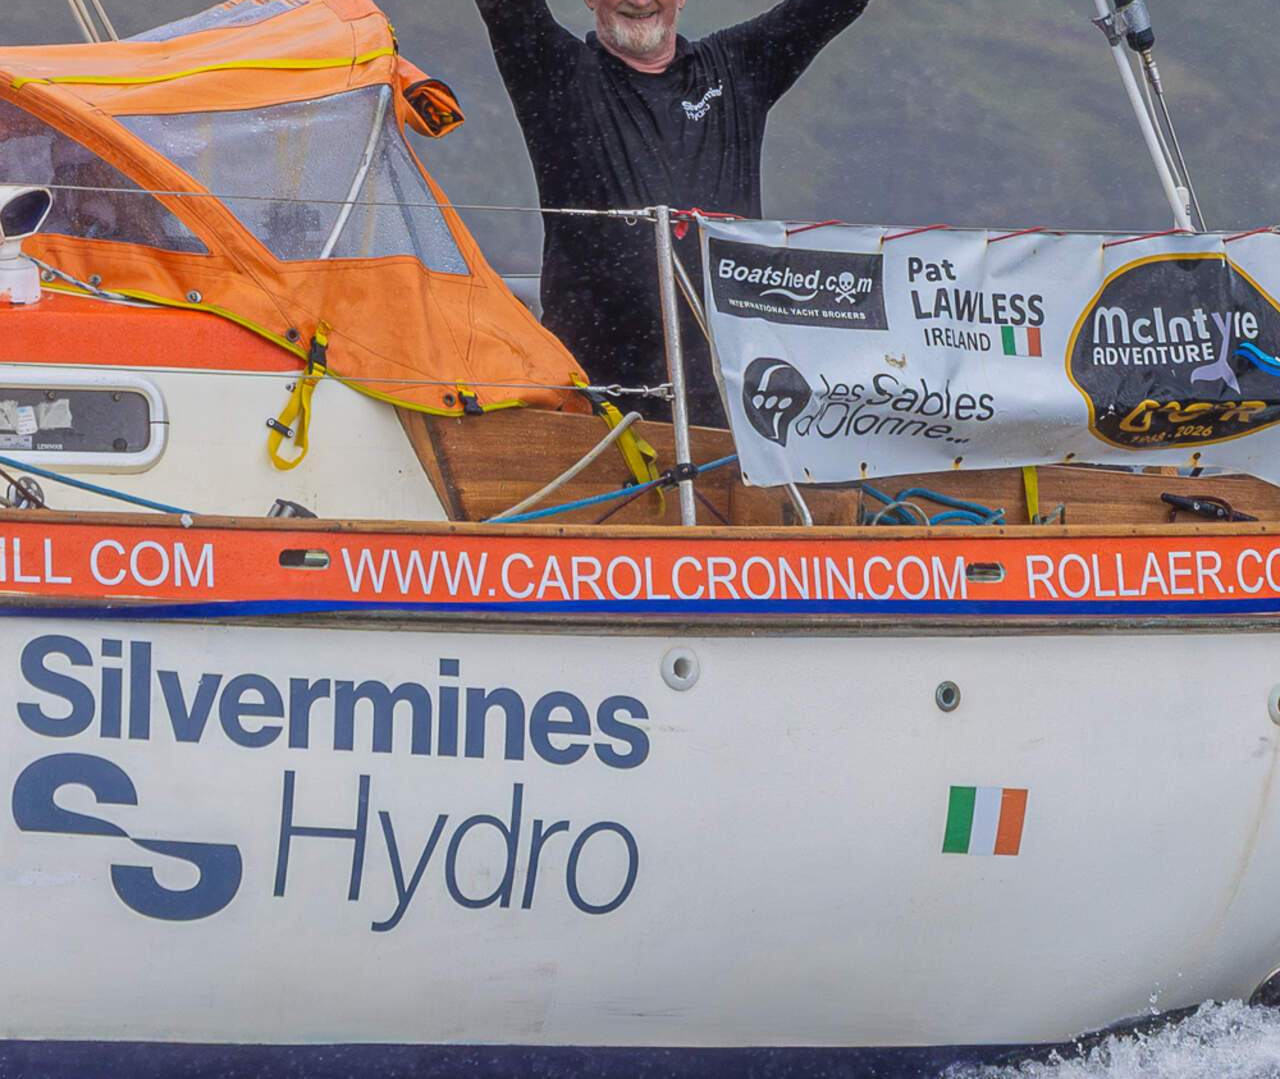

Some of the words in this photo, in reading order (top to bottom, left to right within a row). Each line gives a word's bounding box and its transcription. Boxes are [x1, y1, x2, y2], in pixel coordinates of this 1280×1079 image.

[908, 256, 957, 283] Pat
[728, 298, 788, 316] INTERNATIONAL
[790, 307, 820, 318] YACHT
[822, 309, 867, 320] BROKERS
[910, 287, 1045, 327] LAWLESS
[923, 327, 992, 352] IRELAND
[1093, 341, 1215, 367] ADVENTURE
[866, 373, 995, 422] Sables
[89, 539, 215, 588] COM
[341, 547, 969, 600] WWW.CAROLCRONIN.COM
[16, 633, 650, 770] Silvermines
[272, 770, 640, 933] Hydro
